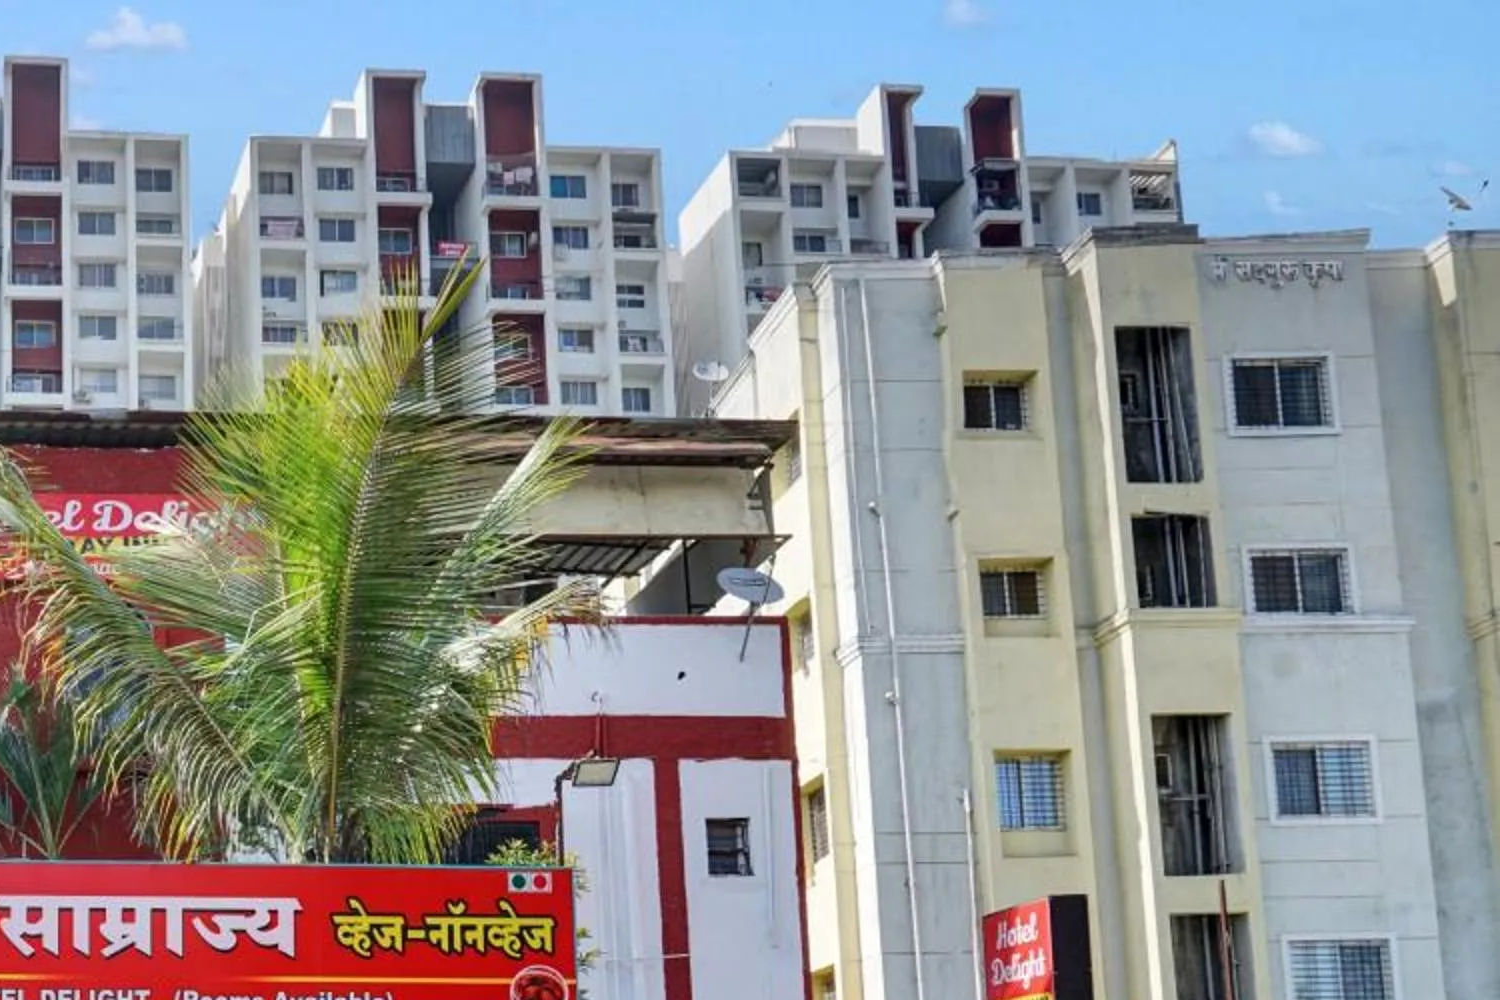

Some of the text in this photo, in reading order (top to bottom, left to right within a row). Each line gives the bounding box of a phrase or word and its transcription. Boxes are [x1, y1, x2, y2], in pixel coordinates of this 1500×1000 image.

[331, 896, 556, 960] व्हेज-नॉनव्हेज
[996, 911, 1039, 949] Hotel
[991, 947, 1046, 990] Delight
